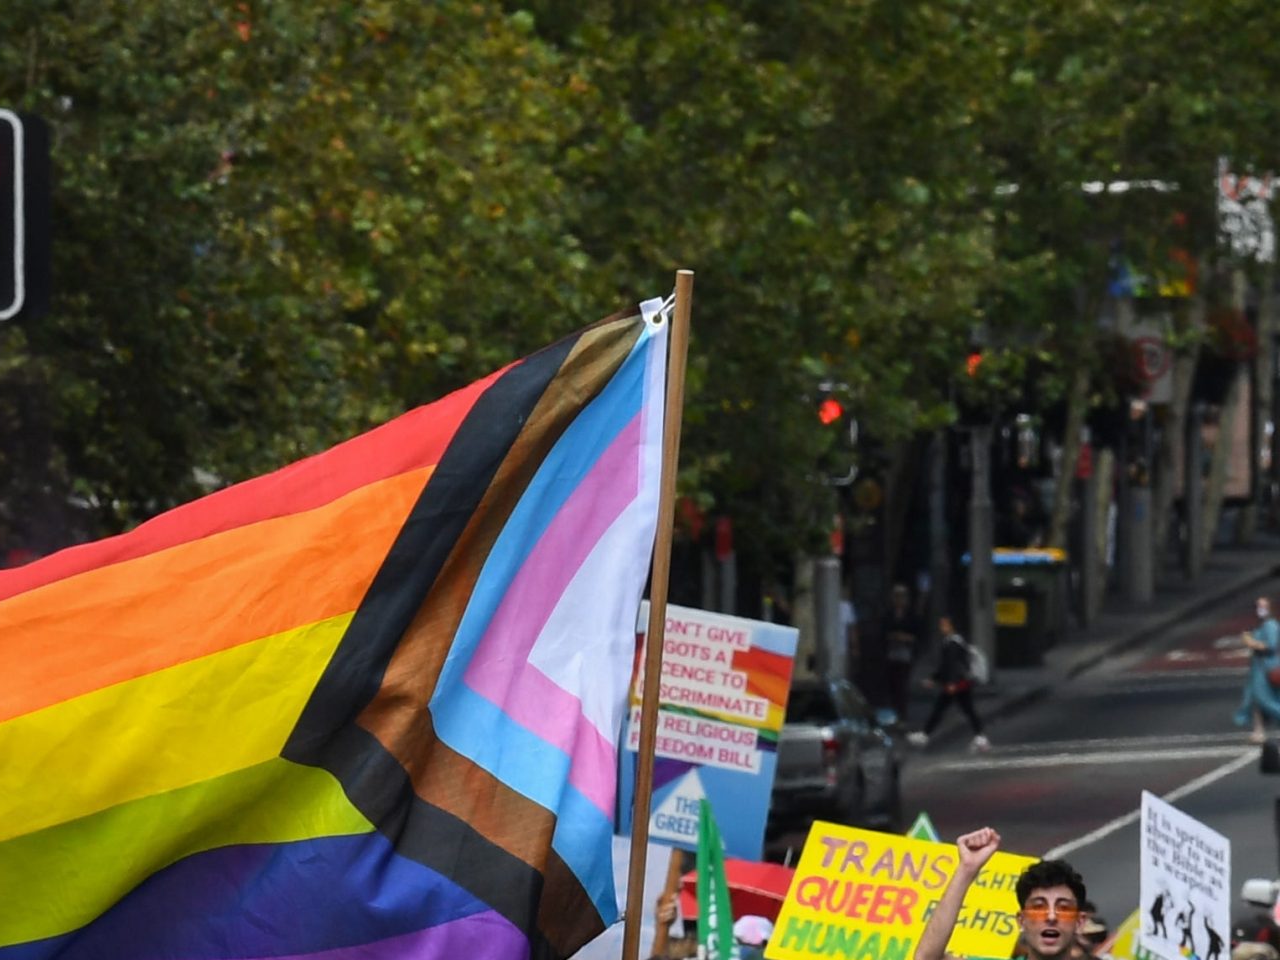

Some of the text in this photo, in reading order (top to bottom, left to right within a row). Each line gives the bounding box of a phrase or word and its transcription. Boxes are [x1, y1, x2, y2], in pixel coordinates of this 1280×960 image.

[707, 627, 746, 646] GIVE
[665, 640, 726, 663] GOTS A
[721, 671, 743, 689] TO
[664, 716, 754, 745] RELIGIOUS
[718, 749, 753, 769] BILL
[821, 837, 954, 889] TRANS
[796, 876, 919, 926] QUEER
